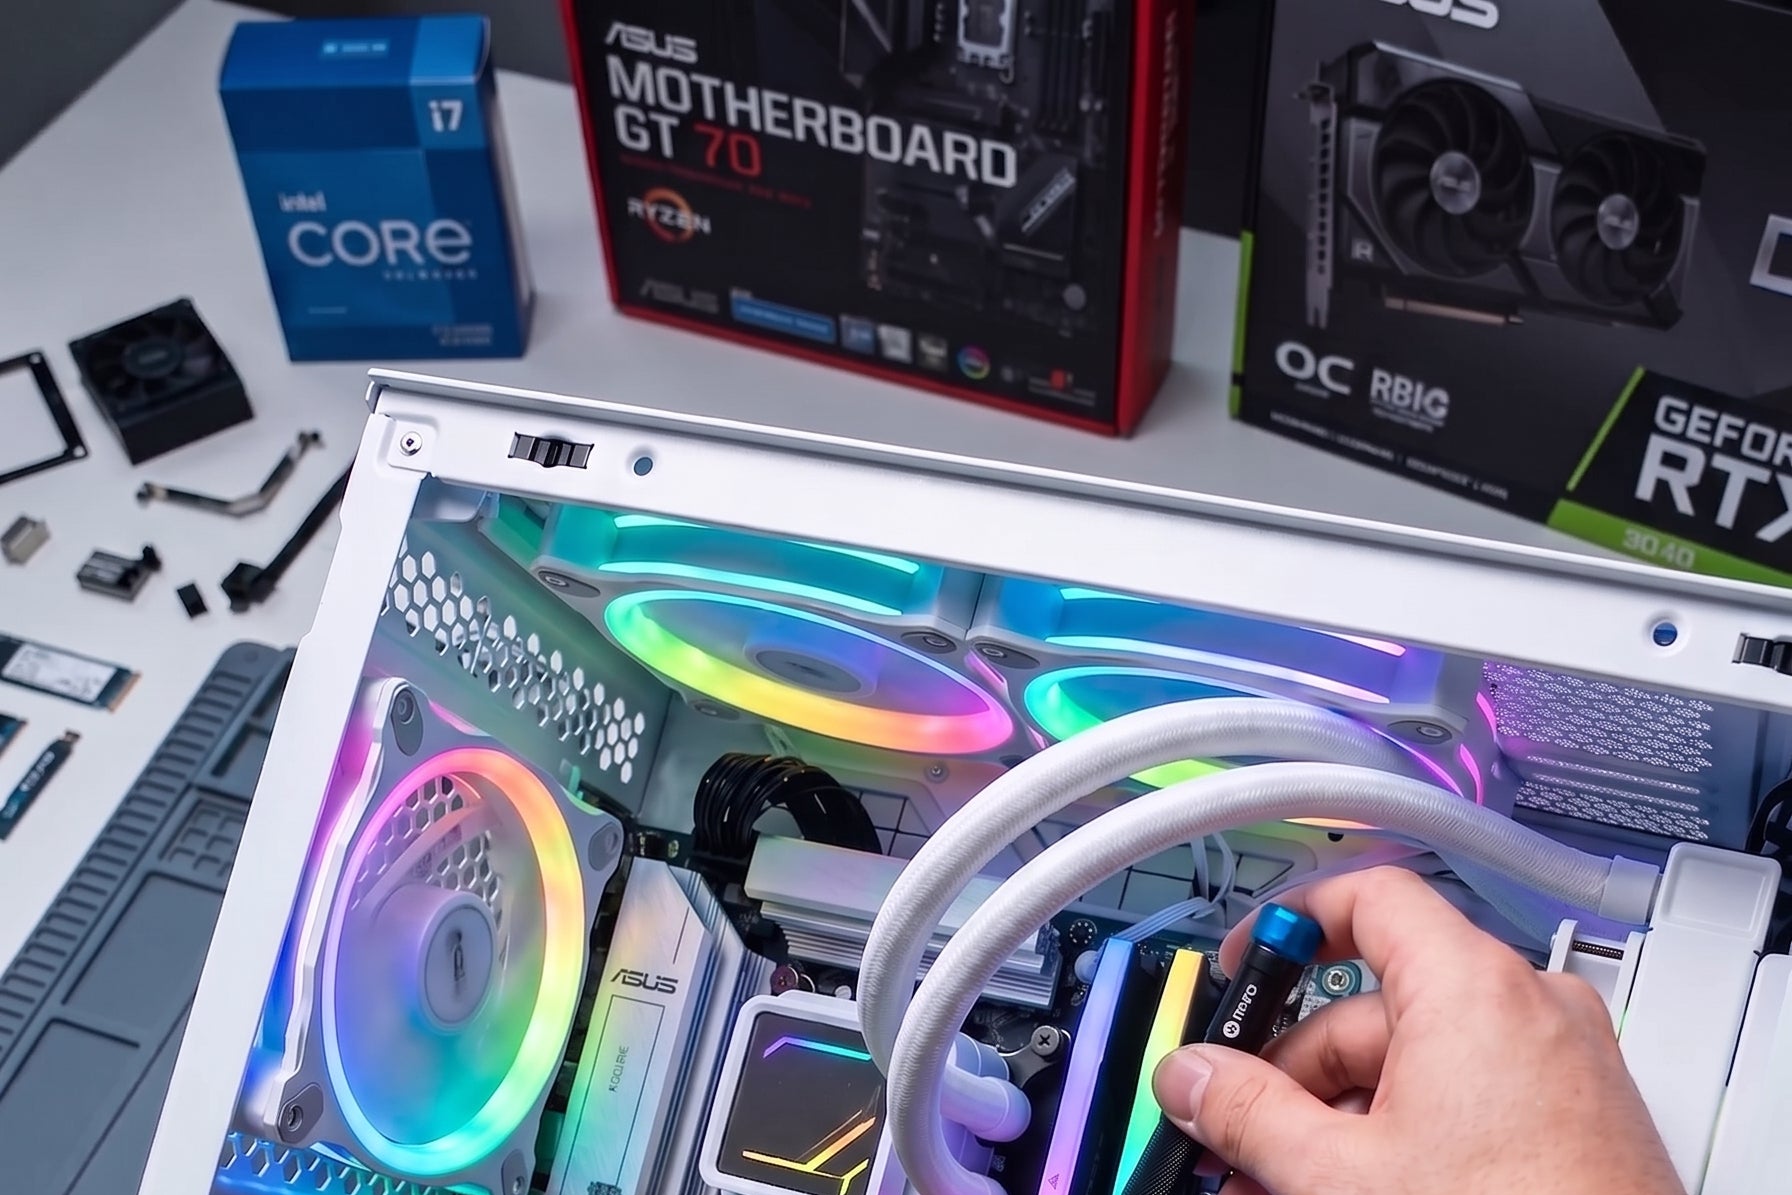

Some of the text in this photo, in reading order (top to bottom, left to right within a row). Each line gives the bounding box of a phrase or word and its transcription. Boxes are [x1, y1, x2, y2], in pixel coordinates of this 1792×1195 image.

[605, 21, 698, 64] ASUS
[428, 100, 464, 132] i7
[606, 54, 1017, 189] MOTHERBOARD
[613, 104, 762, 177] GT 70
[627, 197, 711, 234] RYZEN
[1275, 341, 1354, 395] OC
[610, 969, 678, 995] ASUS
